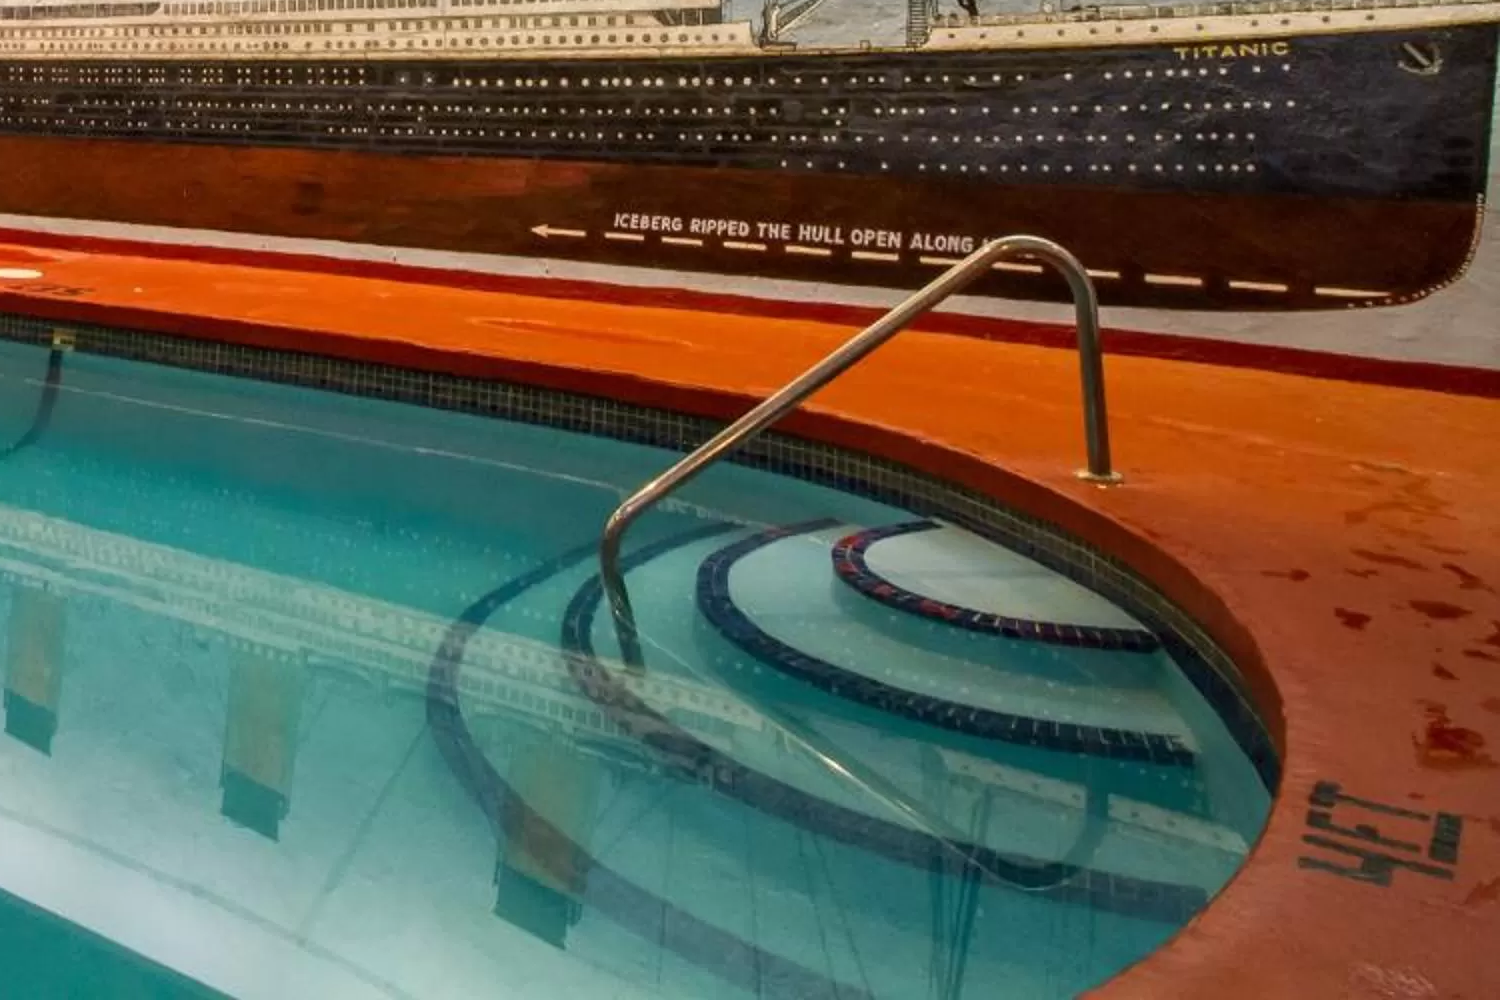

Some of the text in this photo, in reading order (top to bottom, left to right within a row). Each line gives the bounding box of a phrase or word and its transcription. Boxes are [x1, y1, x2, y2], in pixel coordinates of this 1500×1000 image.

[1173, 42, 1289, 61] TITANIC
[614, 212, 683, 232] ICEBERG
[690, 217, 750, 237] RIPPED
[757, 222, 792, 239] THE
[798, 224, 845, 245] HULL
[851, 228, 901, 249] OPEN
[910, 232, 974, 253] ALONG
